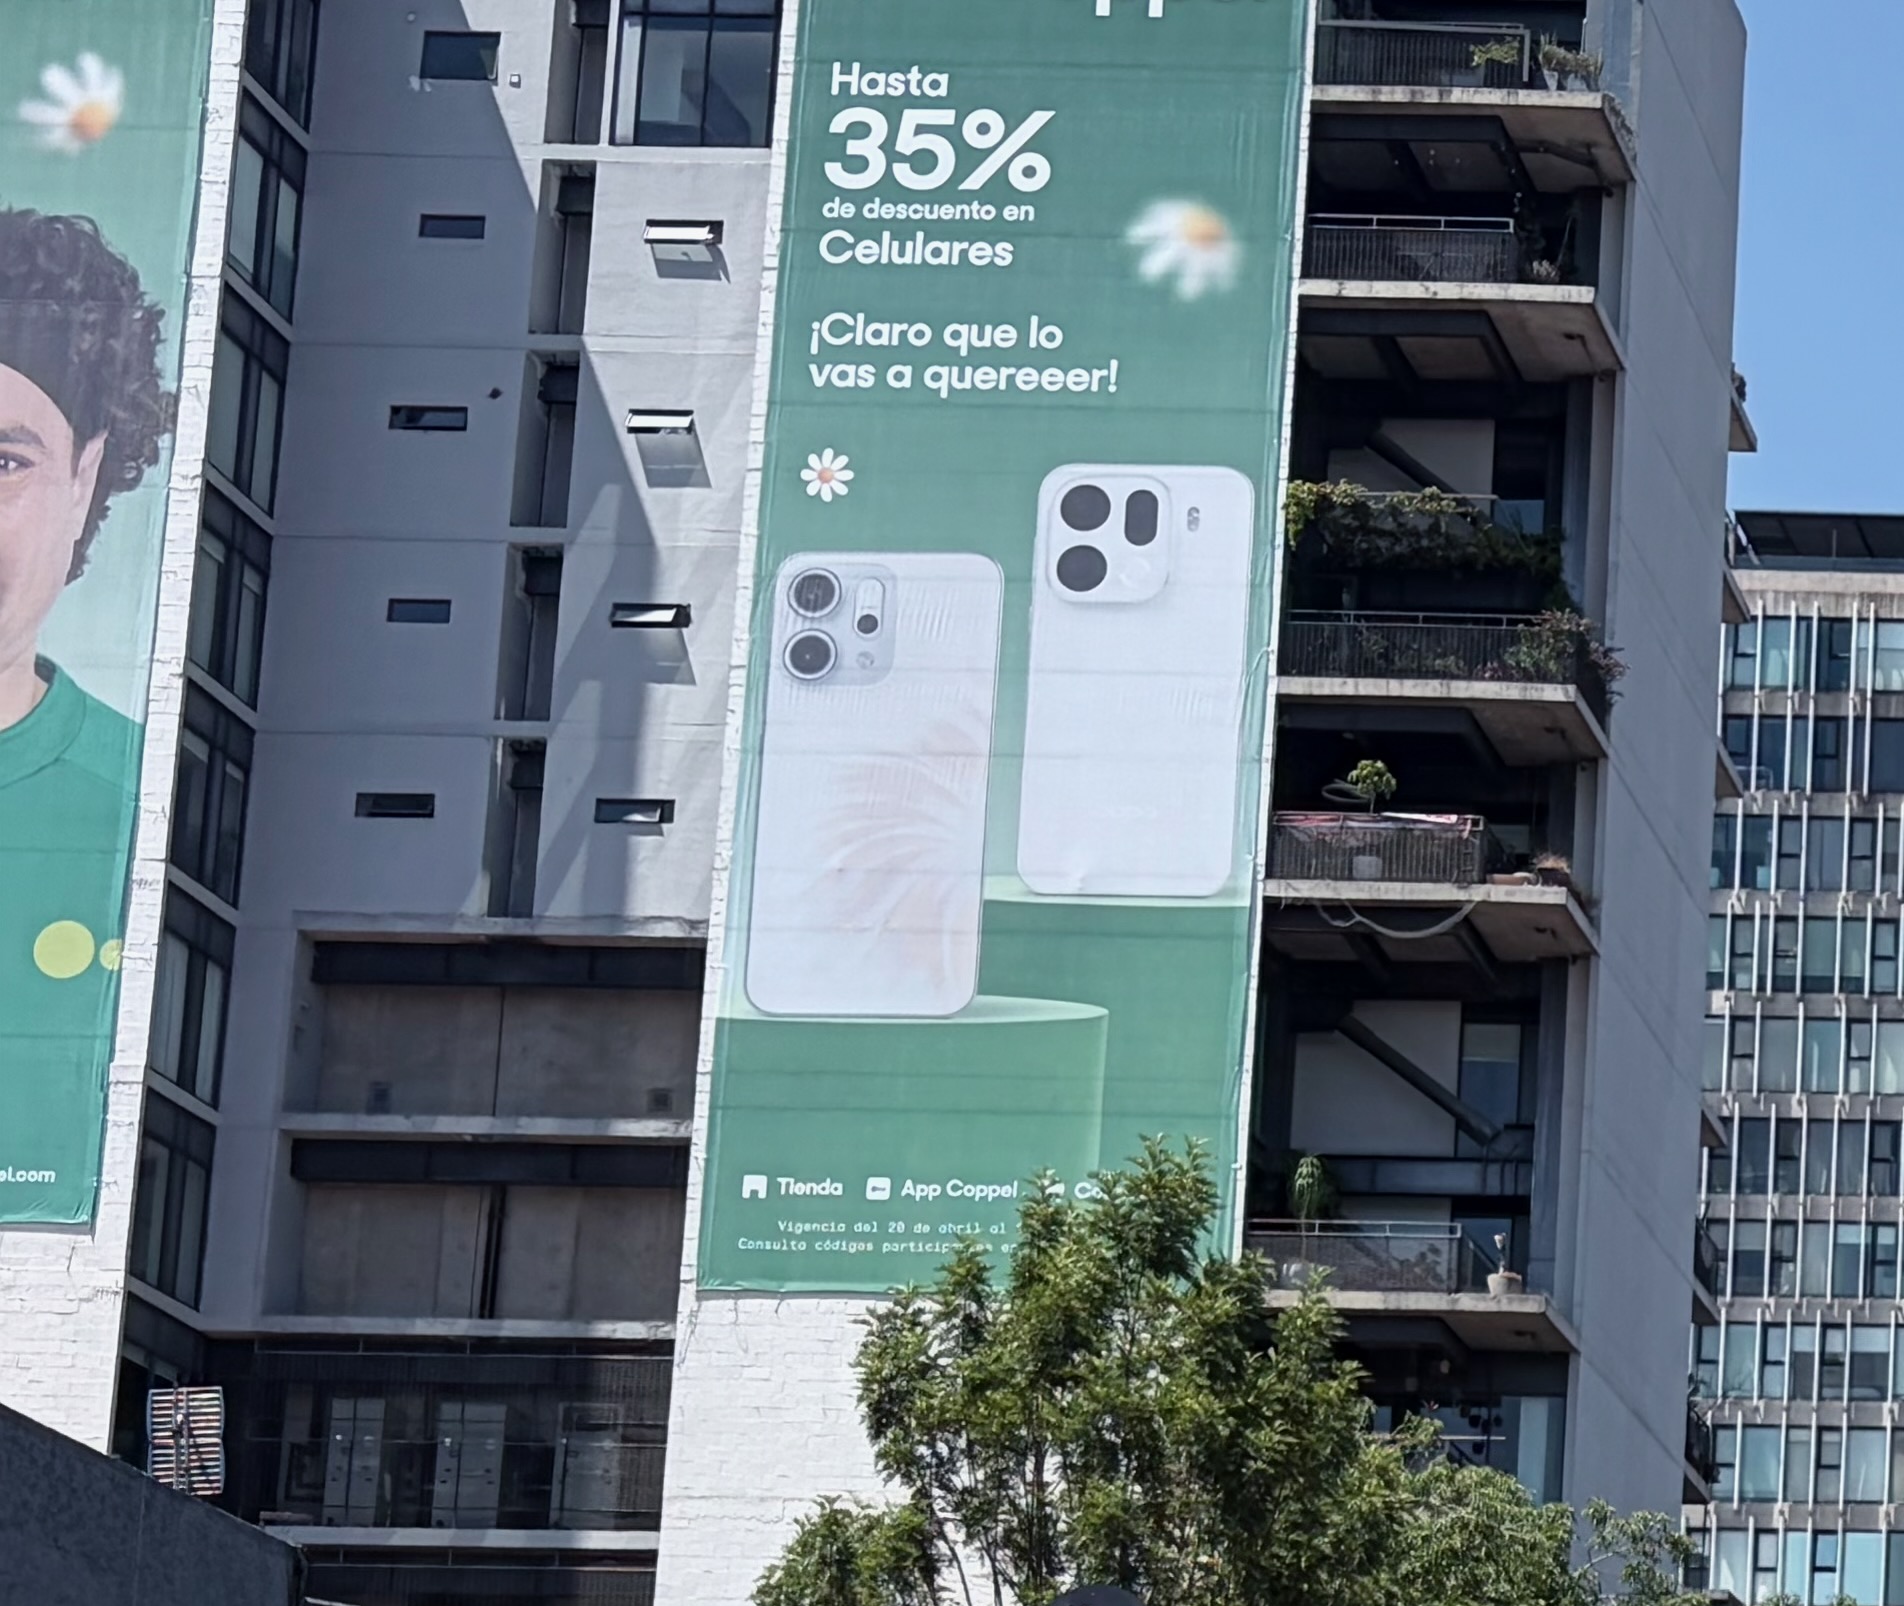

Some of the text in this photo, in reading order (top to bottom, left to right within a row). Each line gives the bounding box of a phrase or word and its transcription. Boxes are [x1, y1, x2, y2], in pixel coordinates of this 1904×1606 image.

[831, 62, 949, 98] Hasta
[824, 107, 1056, 192] 35%
[822, 196, 1035, 222] de descuento en
[818, 230, 1014, 267] Celulares
[810, 311, 1063, 357] ¡Claro que lo
[808, 358, 1119, 398] vas a quereeer!
[776, 1177, 1018, 1203] Tienda App Coppel
[778, 1220, 847, 1234] Vigencia
[853, 1220, 878, 1234] del
[888, 1221, 906, 1234] 20
[913, 1221, 931, 1234] de
[938, 1221, 981, 1235] abril
[737, 1237, 808, 1251] Consulta
[882, 1239, 993, 1255] participes
